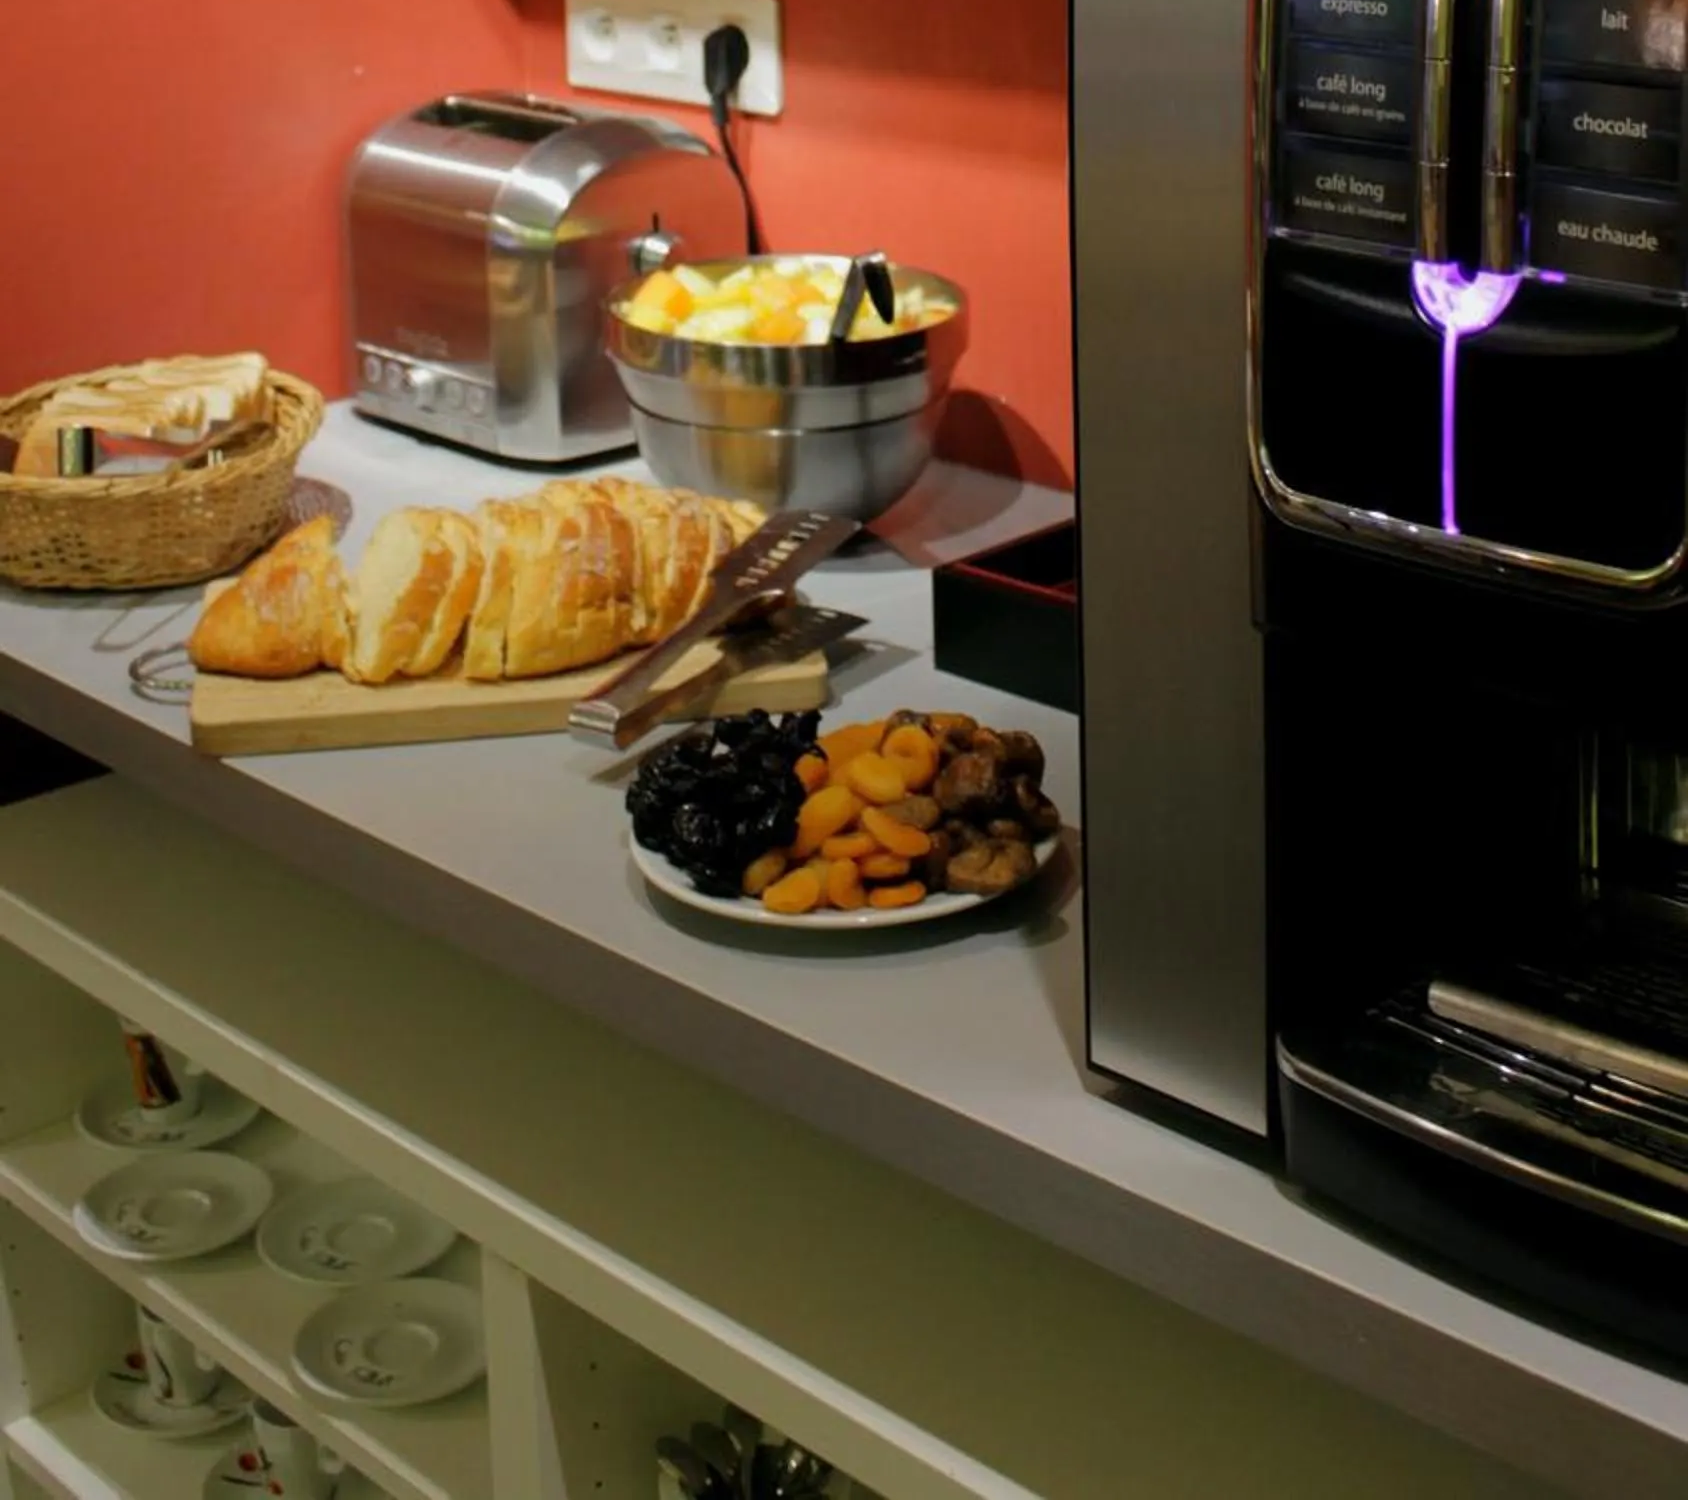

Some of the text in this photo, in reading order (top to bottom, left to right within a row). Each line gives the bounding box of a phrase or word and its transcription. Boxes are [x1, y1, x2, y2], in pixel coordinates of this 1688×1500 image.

[1601, 8, 1629, 30] lait
[1316, 72, 1387, 103] café long
[1573, 112, 1648, 139] chocolat
[1315, 172, 1385, 203] café long
[1557, 219, 1659, 251] eau chaude
